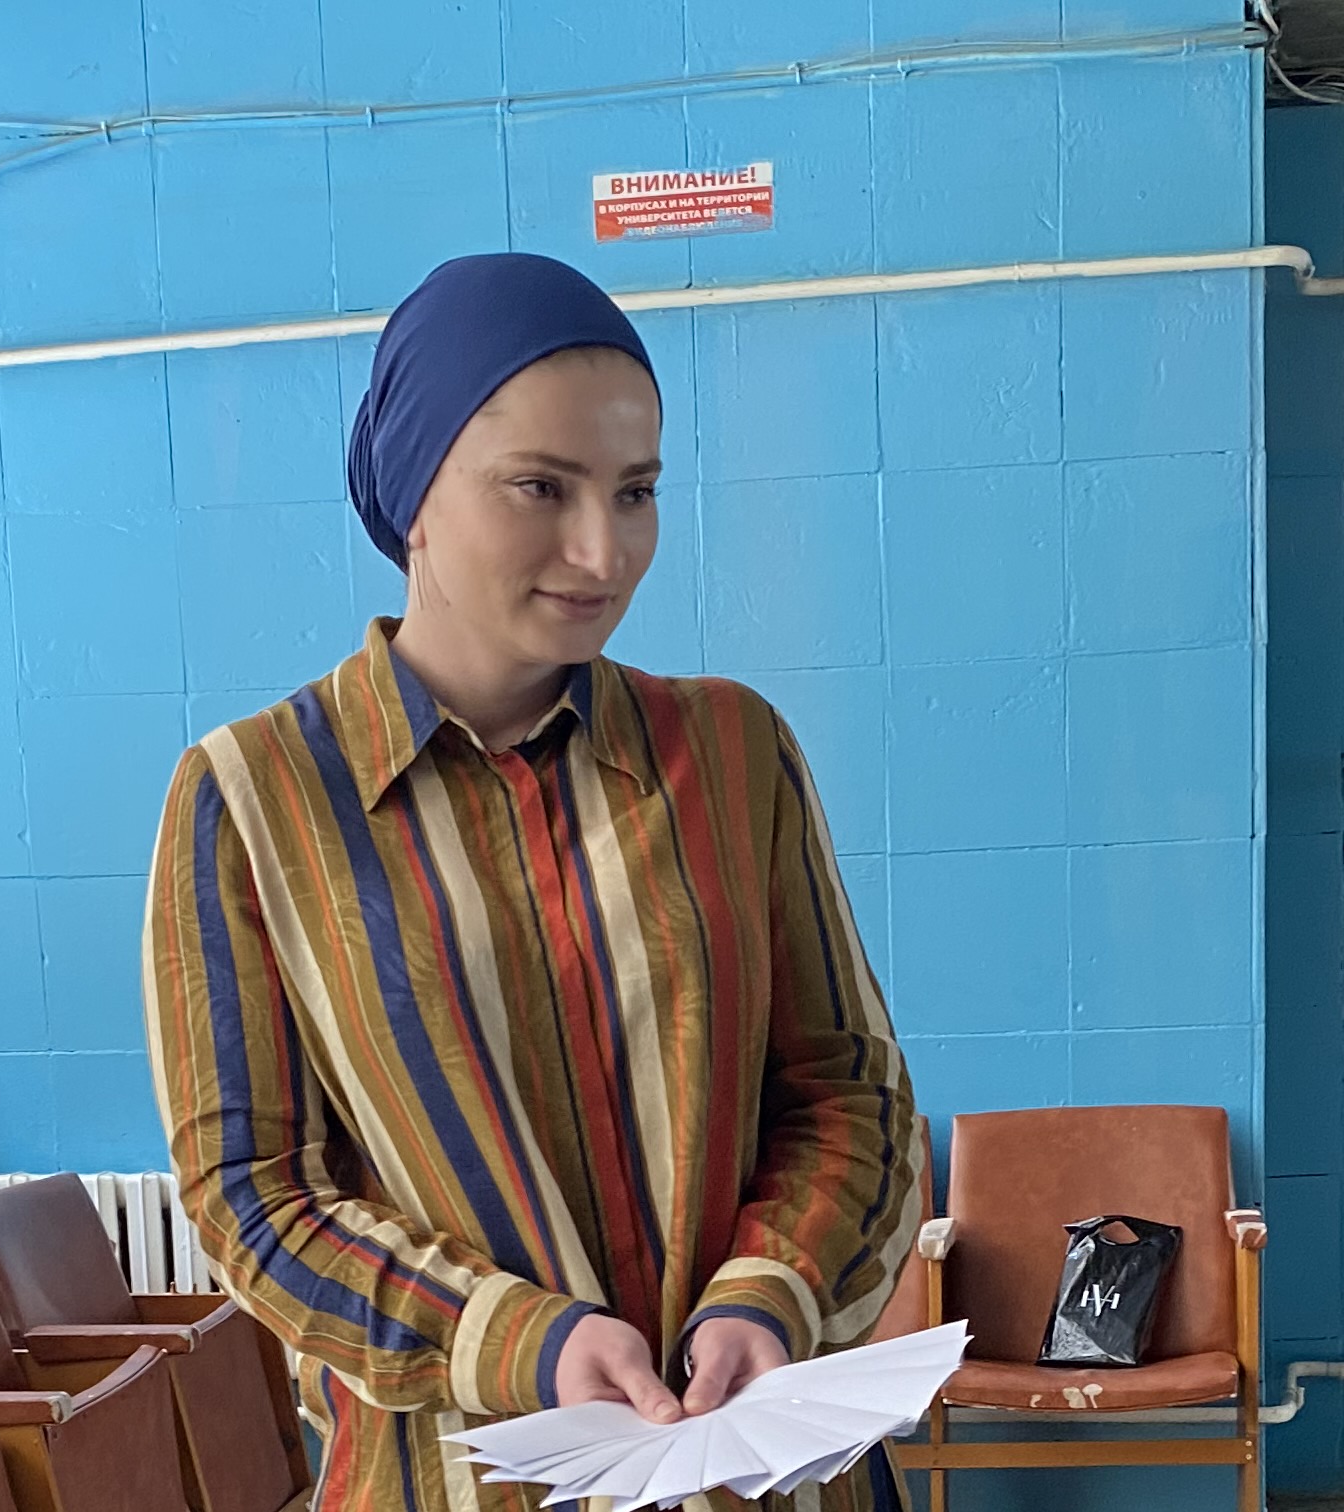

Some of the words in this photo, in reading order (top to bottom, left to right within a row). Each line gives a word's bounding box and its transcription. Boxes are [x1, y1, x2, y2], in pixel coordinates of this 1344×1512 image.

[611, 166, 757, 195] ВНИМАНИЕ!
[599, 204, 606, 214] В
[608, 200, 667, 213] КОРПУСАХ
[669, 199, 677, 209] И
[679, 198, 695, 208] НА
[697, 191, 770, 206] ТЕРРИТОРИИ
[616, 209, 702, 225] УНИВЕРСИТЕТА
